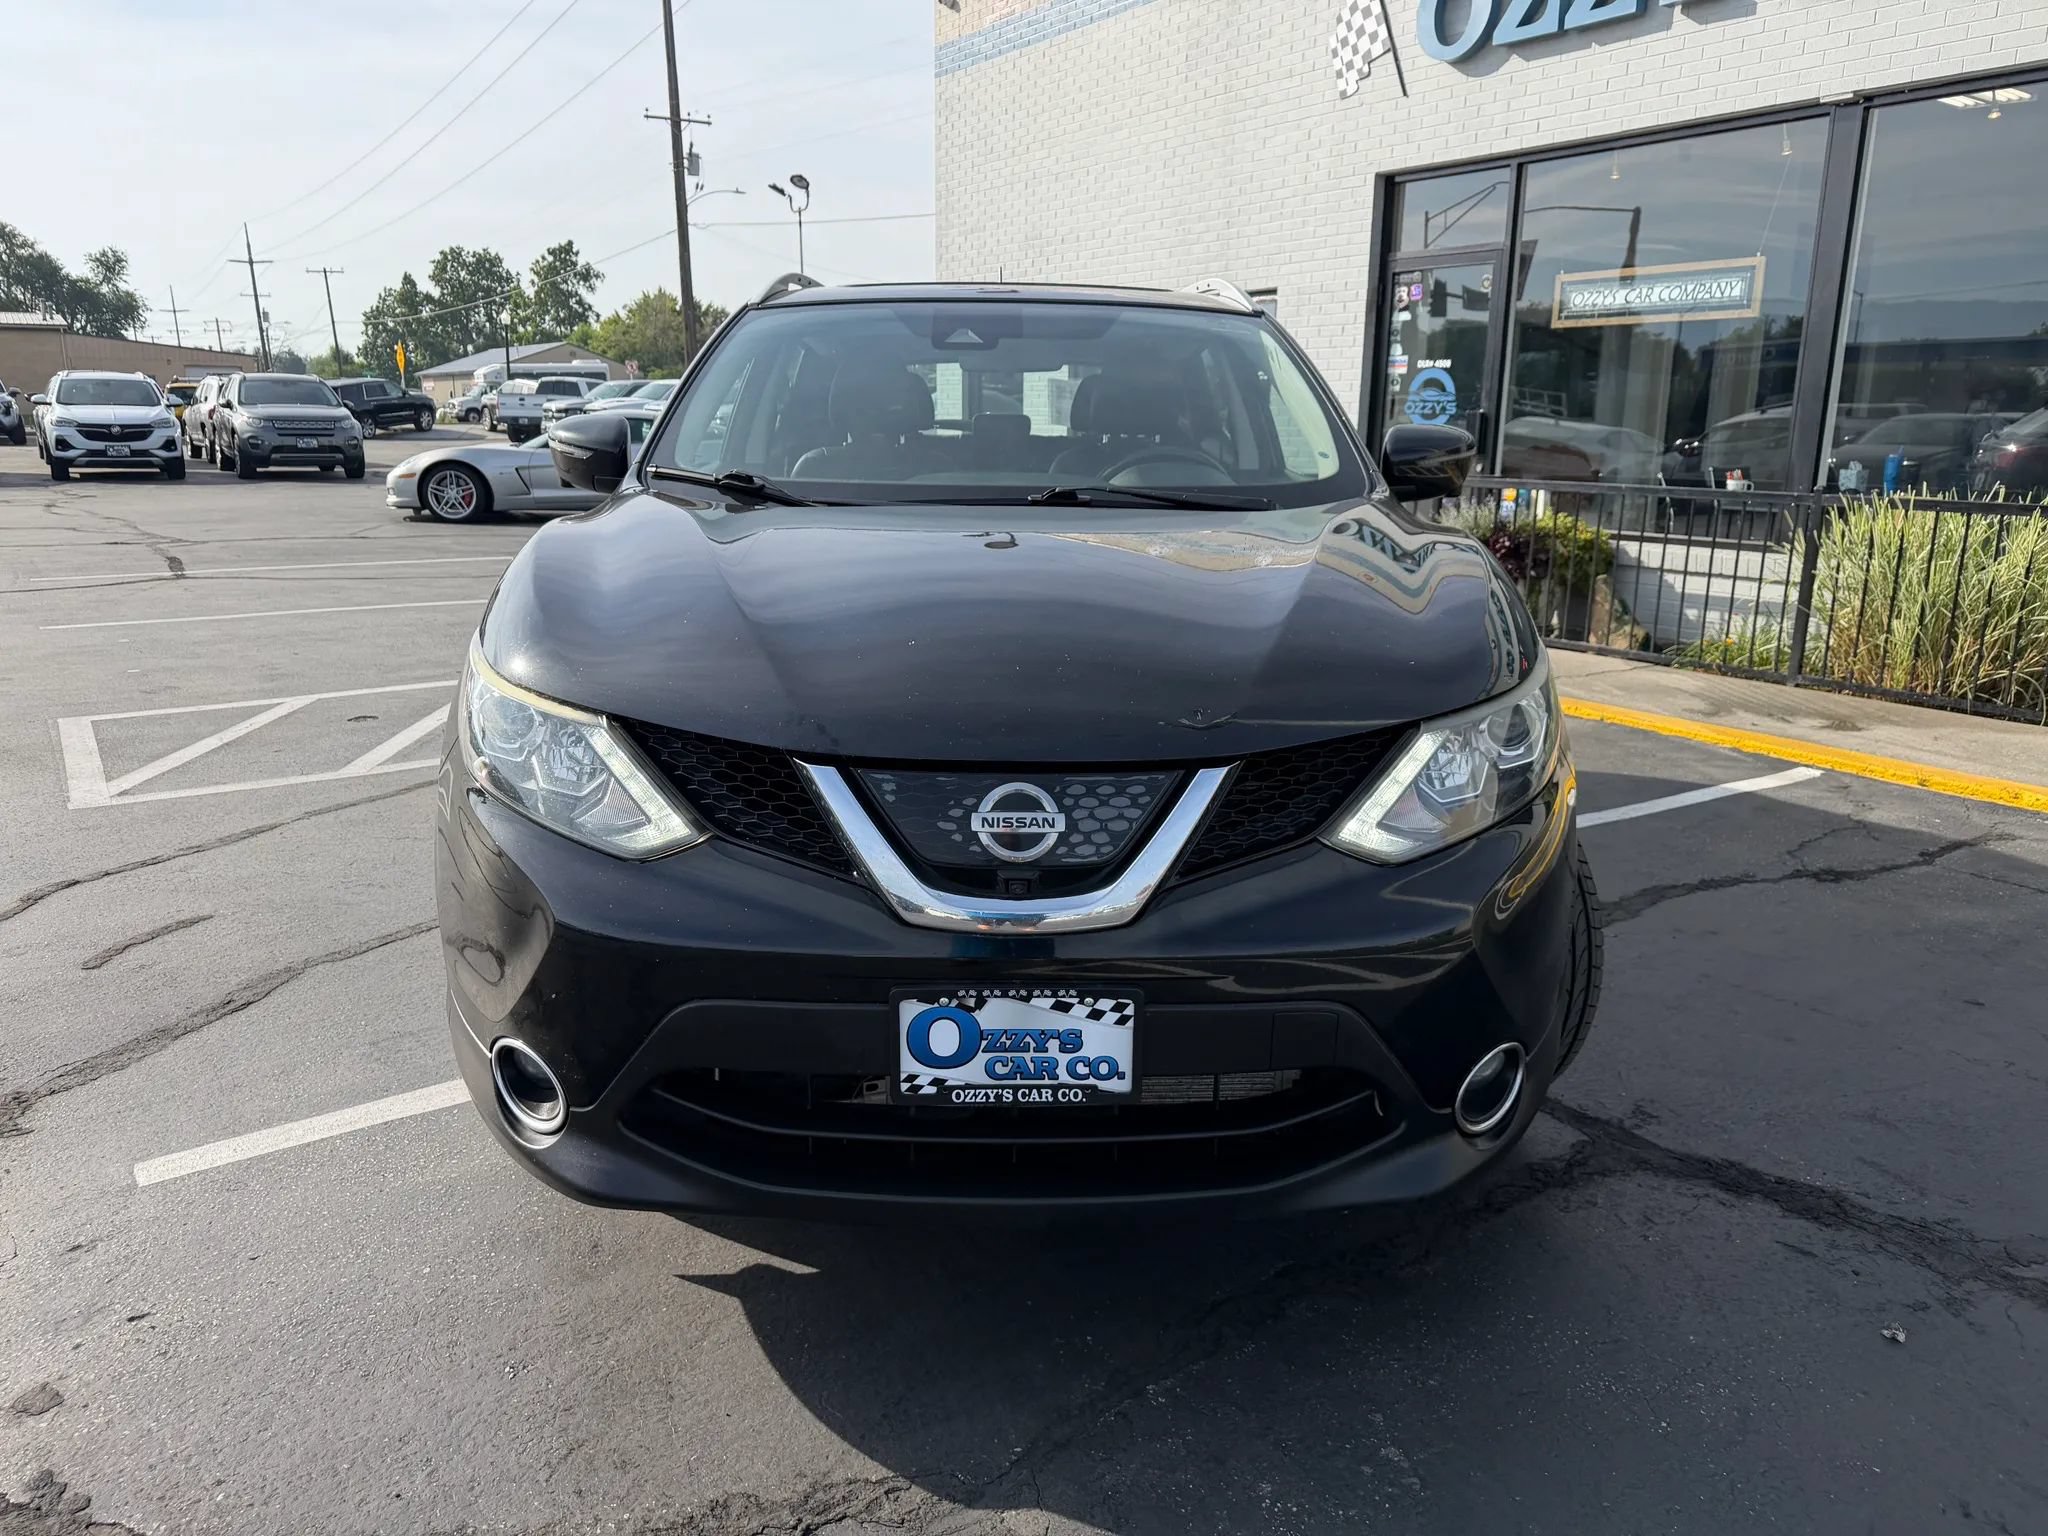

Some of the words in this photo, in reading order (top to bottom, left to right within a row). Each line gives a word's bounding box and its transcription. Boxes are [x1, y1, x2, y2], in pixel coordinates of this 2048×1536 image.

[1625, 286, 1654, 304] CAR
[1659, 280, 1741, 303] COMPANY
[1404, 400, 1457, 415] OZZY'S
[981, 816, 1055, 829] NISSAN
[906, 1006, 1083, 1069] OZZY'S
[984, 1055, 1059, 1080] CAR
[1066, 1055, 1125, 1081] CO.
[951, 1088, 1013, 1103] OZZY'S
[1017, 1088, 1053, 1102] CAR
[1057, 1088, 1086, 1102] CO.
